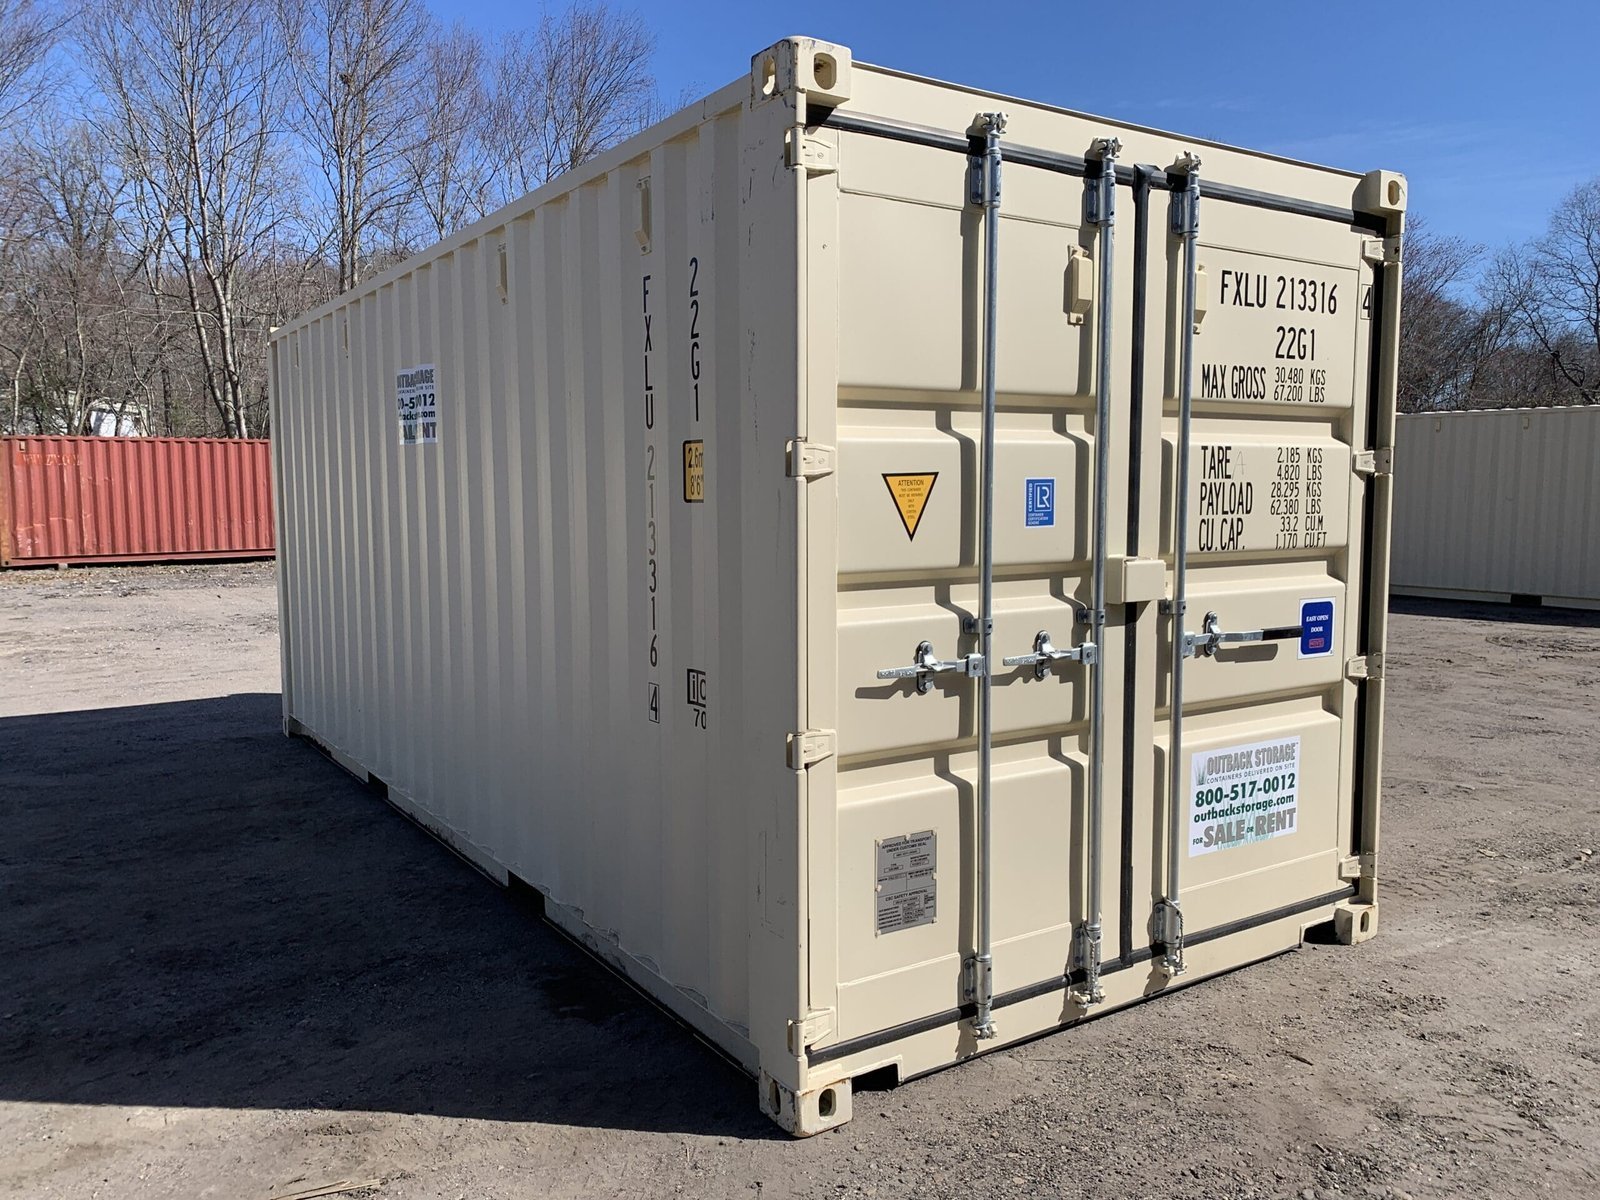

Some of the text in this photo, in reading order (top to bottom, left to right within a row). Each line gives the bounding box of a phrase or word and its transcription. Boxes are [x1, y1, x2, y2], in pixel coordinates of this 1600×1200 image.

[1220, 270, 1371, 318] FXLU 213316 4
[689, 257, 700, 422] 22G1
[1275, 326, 1316, 361] 22G1
[1201, 364, 1227, 399] MAX
[1231, 366, 1266, 400] GROSS
[1310, 369, 1327, 386] KGS
[1309, 386, 1325, 403] LBS
[1201, 446, 1232, 480] TARE
[1307, 448, 1323, 464] KGS
[1307, 465, 1322, 481] LBS
[642, 275, 658, 721] FXLU 213316 4
[898, 479, 925, 487] ATTENTION
[1199, 481, 1253, 515] PAYLOAD
[1306, 481, 1322, 498] KGS
[1280, 516, 1298, 532] 33.2
[1305, 516, 1324, 532] CU.M
[1305, 499, 1321, 515] LBS
[1206, 742, 1296, 776] OUTBACK STORAGE
[1206, 772, 1242, 784] CONTAINERS
[1243, 768, 1273, 777] DELIVERED
[1284, 762, 1295, 770] SITE
[1195, 772, 1296, 808] 800-517-0012
[1193, 794, 1294, 824] outbackstorage.com
[911, 836, 931, 844] TRANSPORT
[1192, 807, 1297, 848] FOR SALE OR RENT
